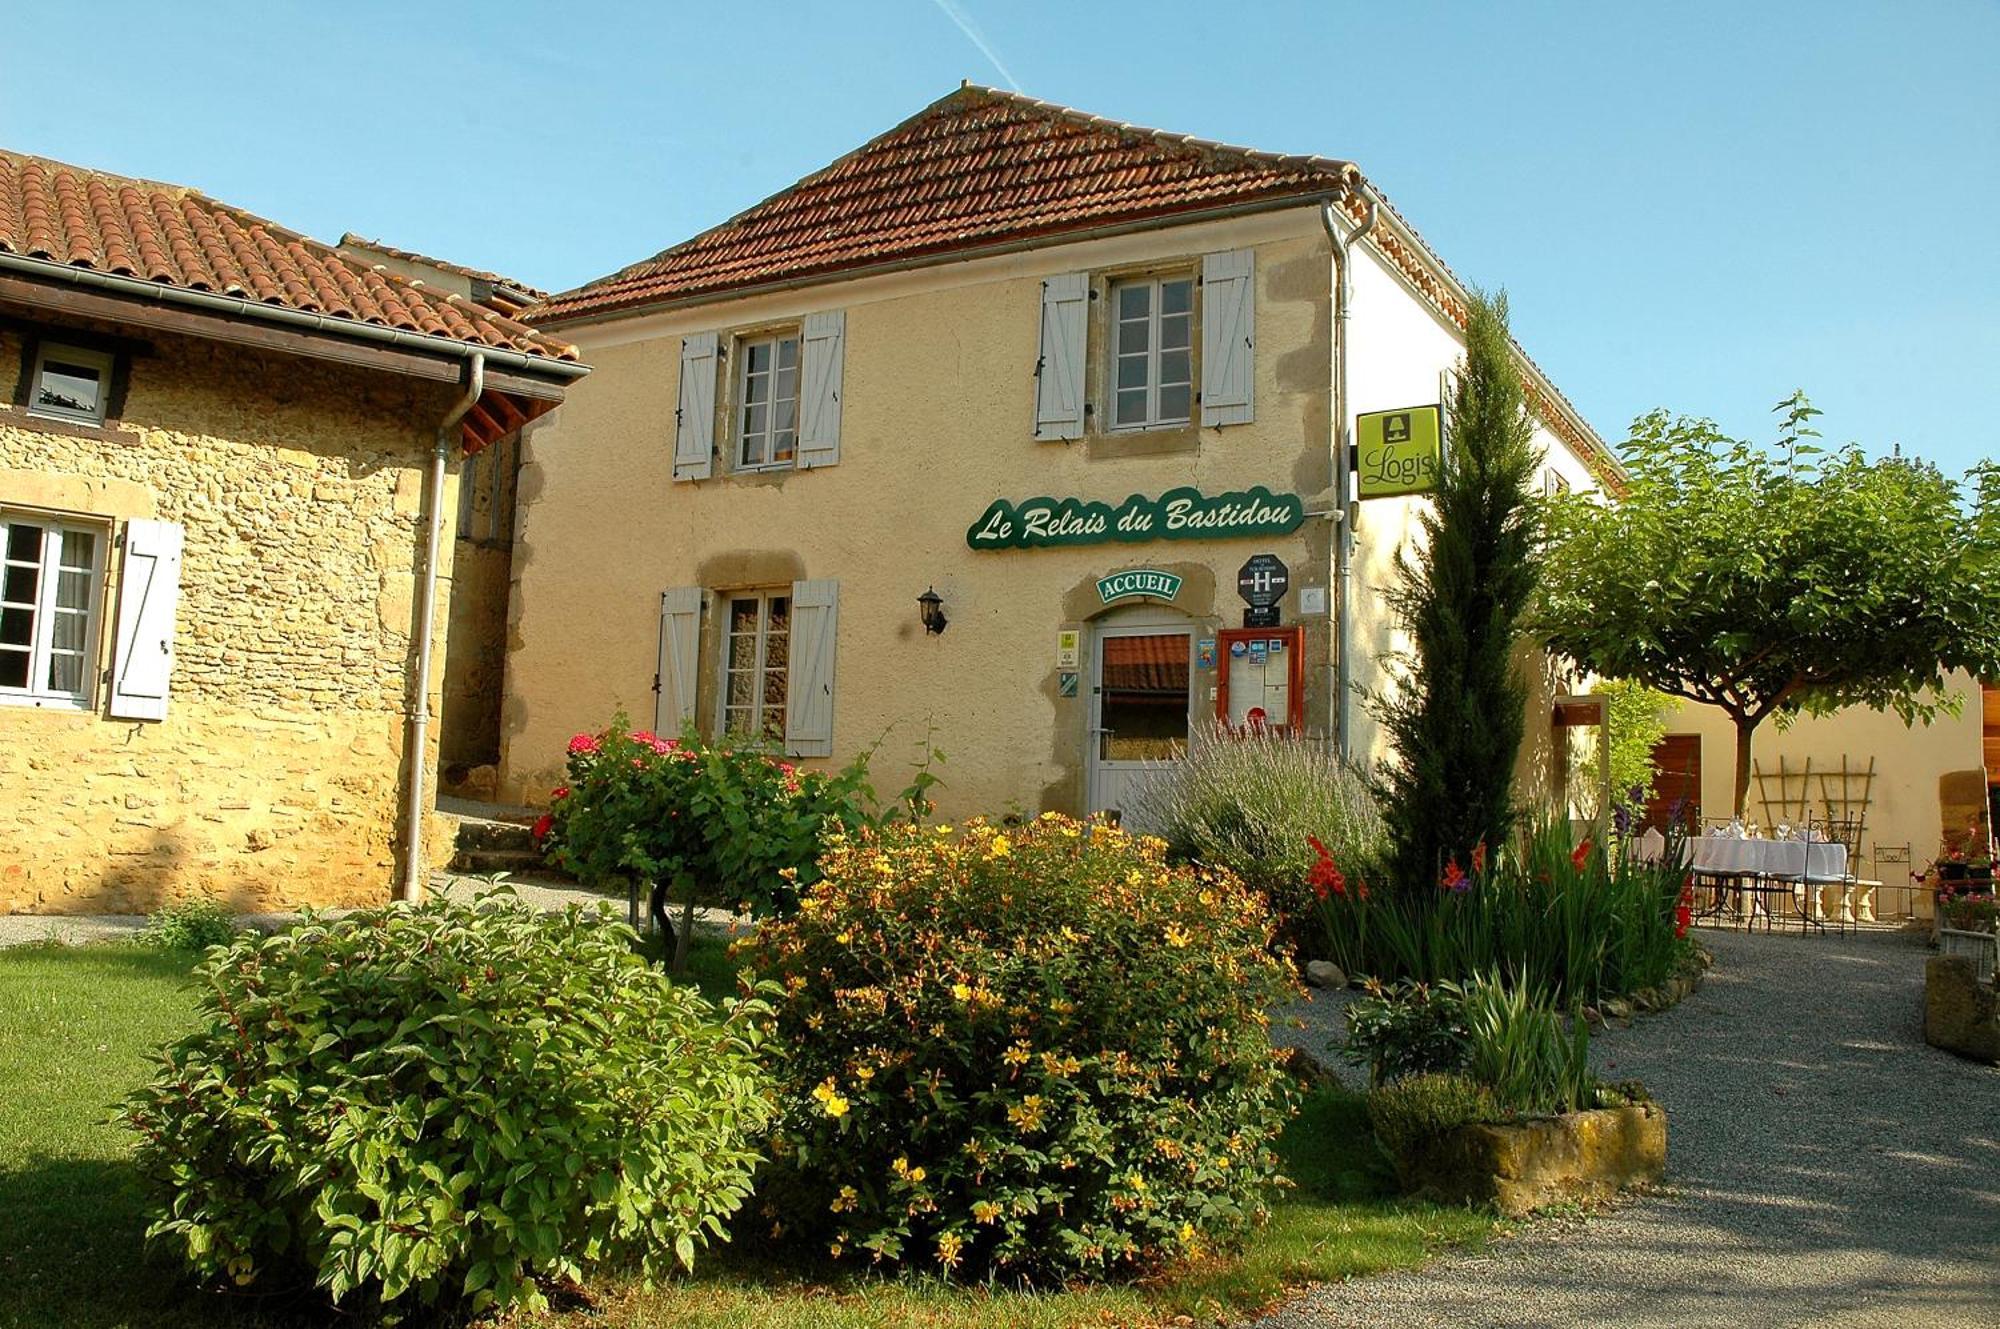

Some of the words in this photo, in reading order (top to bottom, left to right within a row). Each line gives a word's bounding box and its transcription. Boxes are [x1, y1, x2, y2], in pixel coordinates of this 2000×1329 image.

[1363, 444, 1431, 485] Logis
[976, 511, 1012, 540] Le
[1023, 508, 1107, 538] Relais
[1118, 506, 1153, 533] du
[1166, 498, 1291, 530] Bastidou
[1104, 573, 1174, 598] ACCUEIL
[1254, 571, 1270, 592] H
